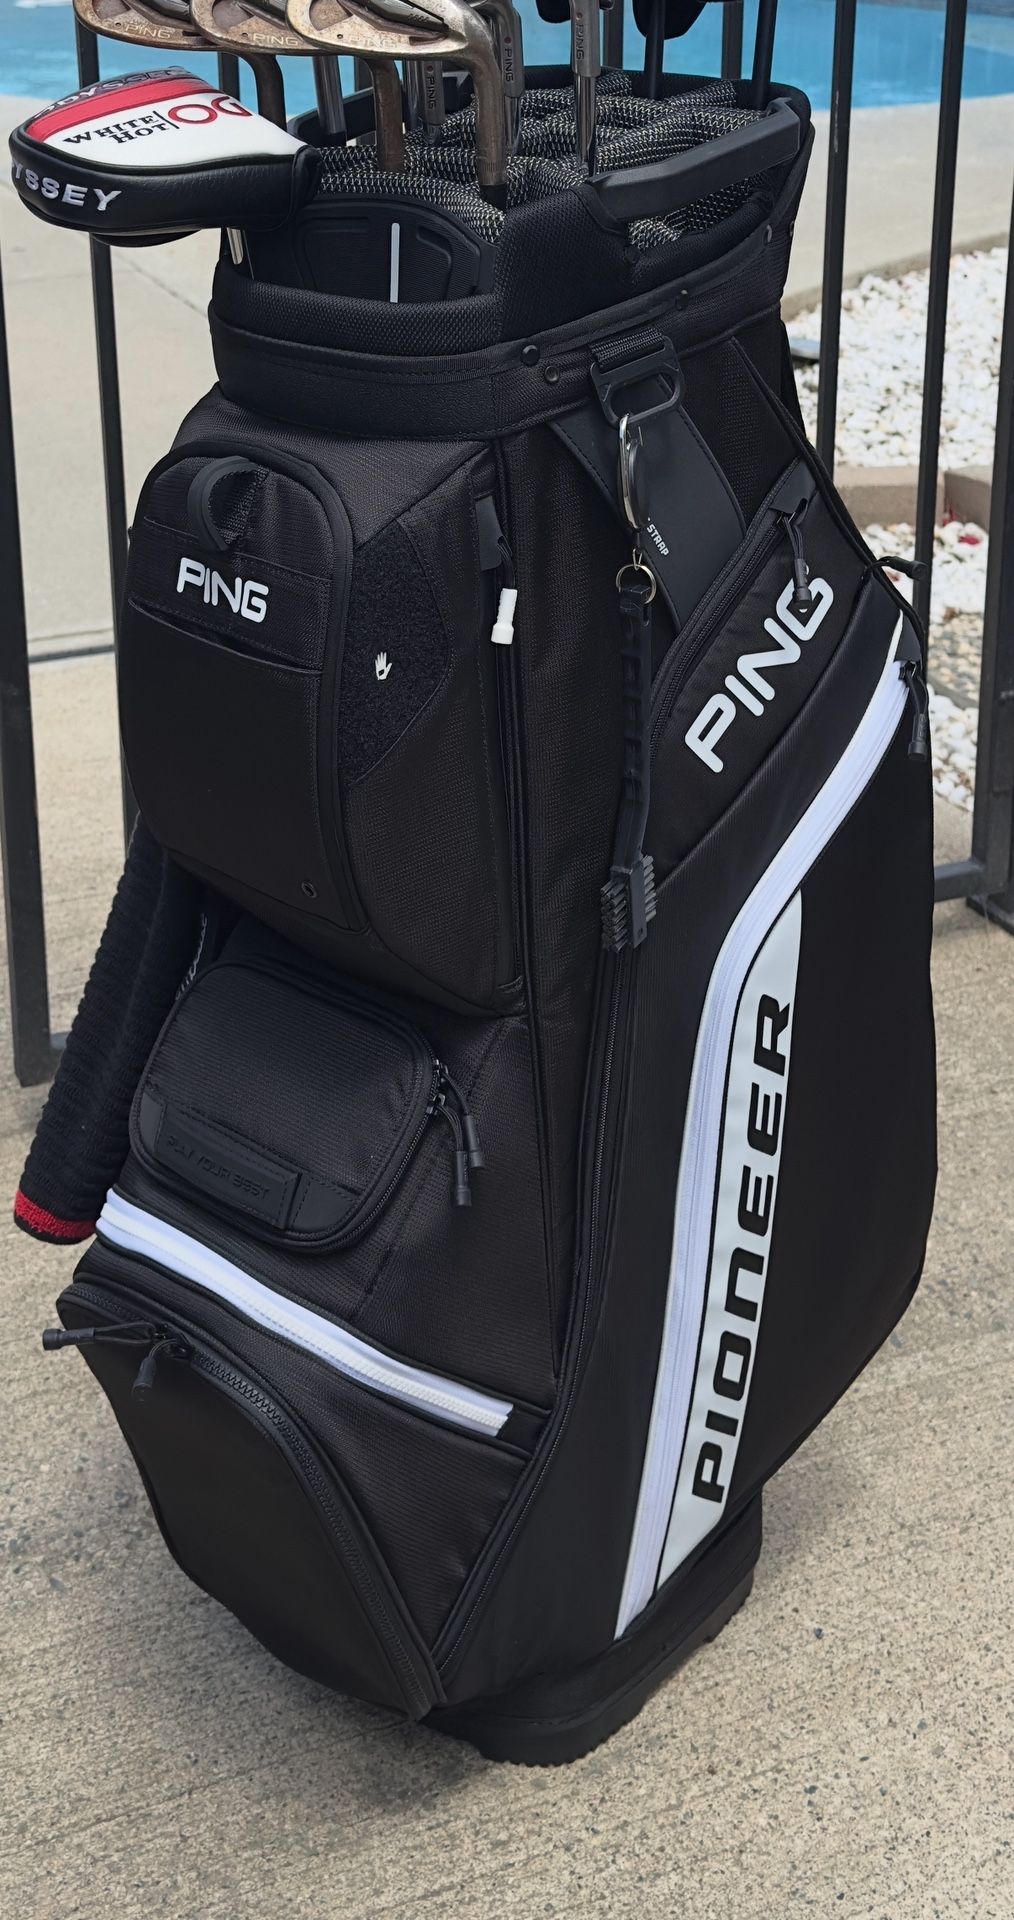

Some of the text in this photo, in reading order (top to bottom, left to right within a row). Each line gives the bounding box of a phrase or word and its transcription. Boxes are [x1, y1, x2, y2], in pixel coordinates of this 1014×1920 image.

[125, 23, 171, 39] PING
[252, 32, 299, 46] PING
[576, 24, 585, 60] PING
[504, 48, 514, 83] PING
[425, 76, 437, 110] PING
[63, 115, 160, 143] WHITE
[109, 122, 171, 144] HOT
[12, 159, 122, 212] YSSEY
[646, 523, 670, 556] STRAP
[176, 556, 270, 624] PING
[684, 577, 834, 773] PING
[197, 1155, 232, 1181] YOUR
